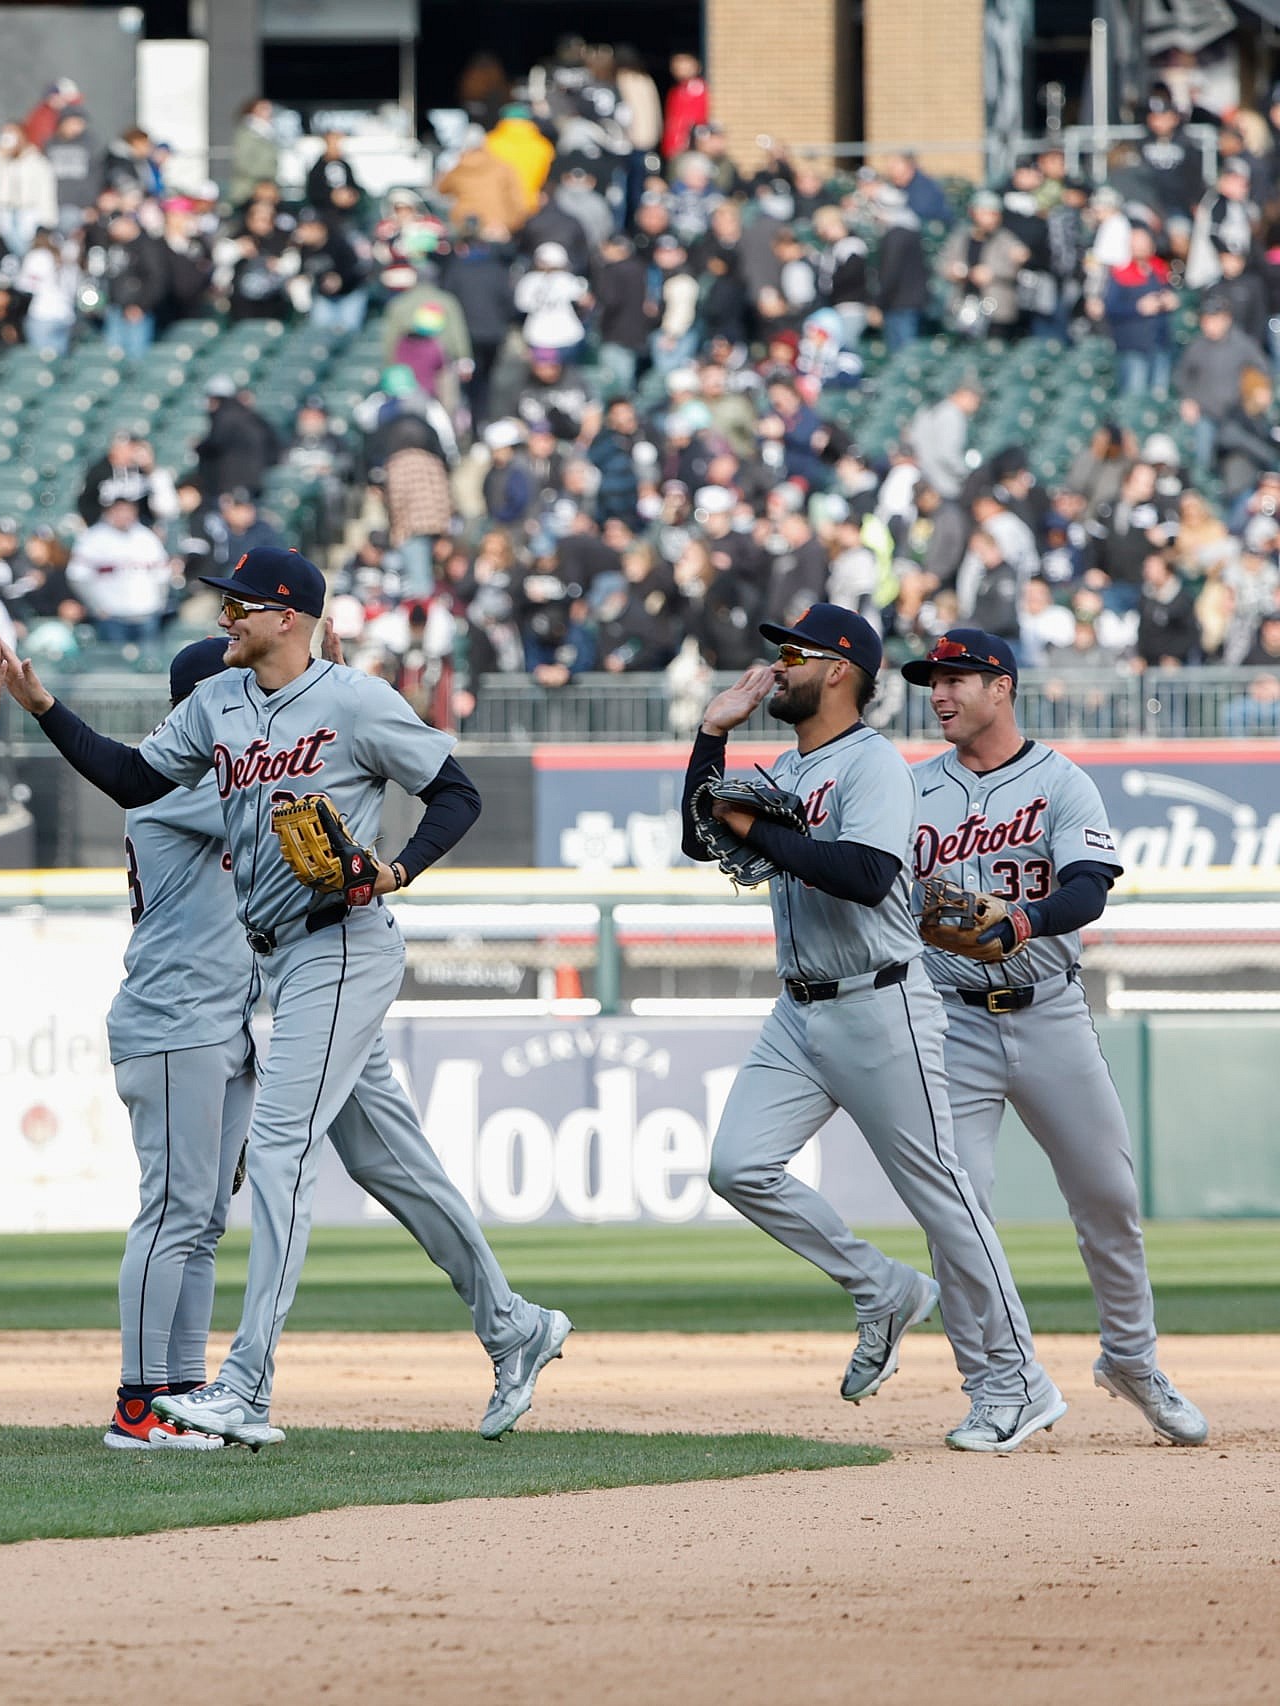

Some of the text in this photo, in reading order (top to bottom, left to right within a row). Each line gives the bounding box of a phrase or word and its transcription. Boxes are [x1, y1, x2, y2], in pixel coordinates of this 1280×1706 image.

[213, 728, 337, 800] Detroit
[913, 796, 1049, 880] Detroit
[991, 859, 1052, 902] 33
[501, 1028, 671, 1079] CERVEZA
